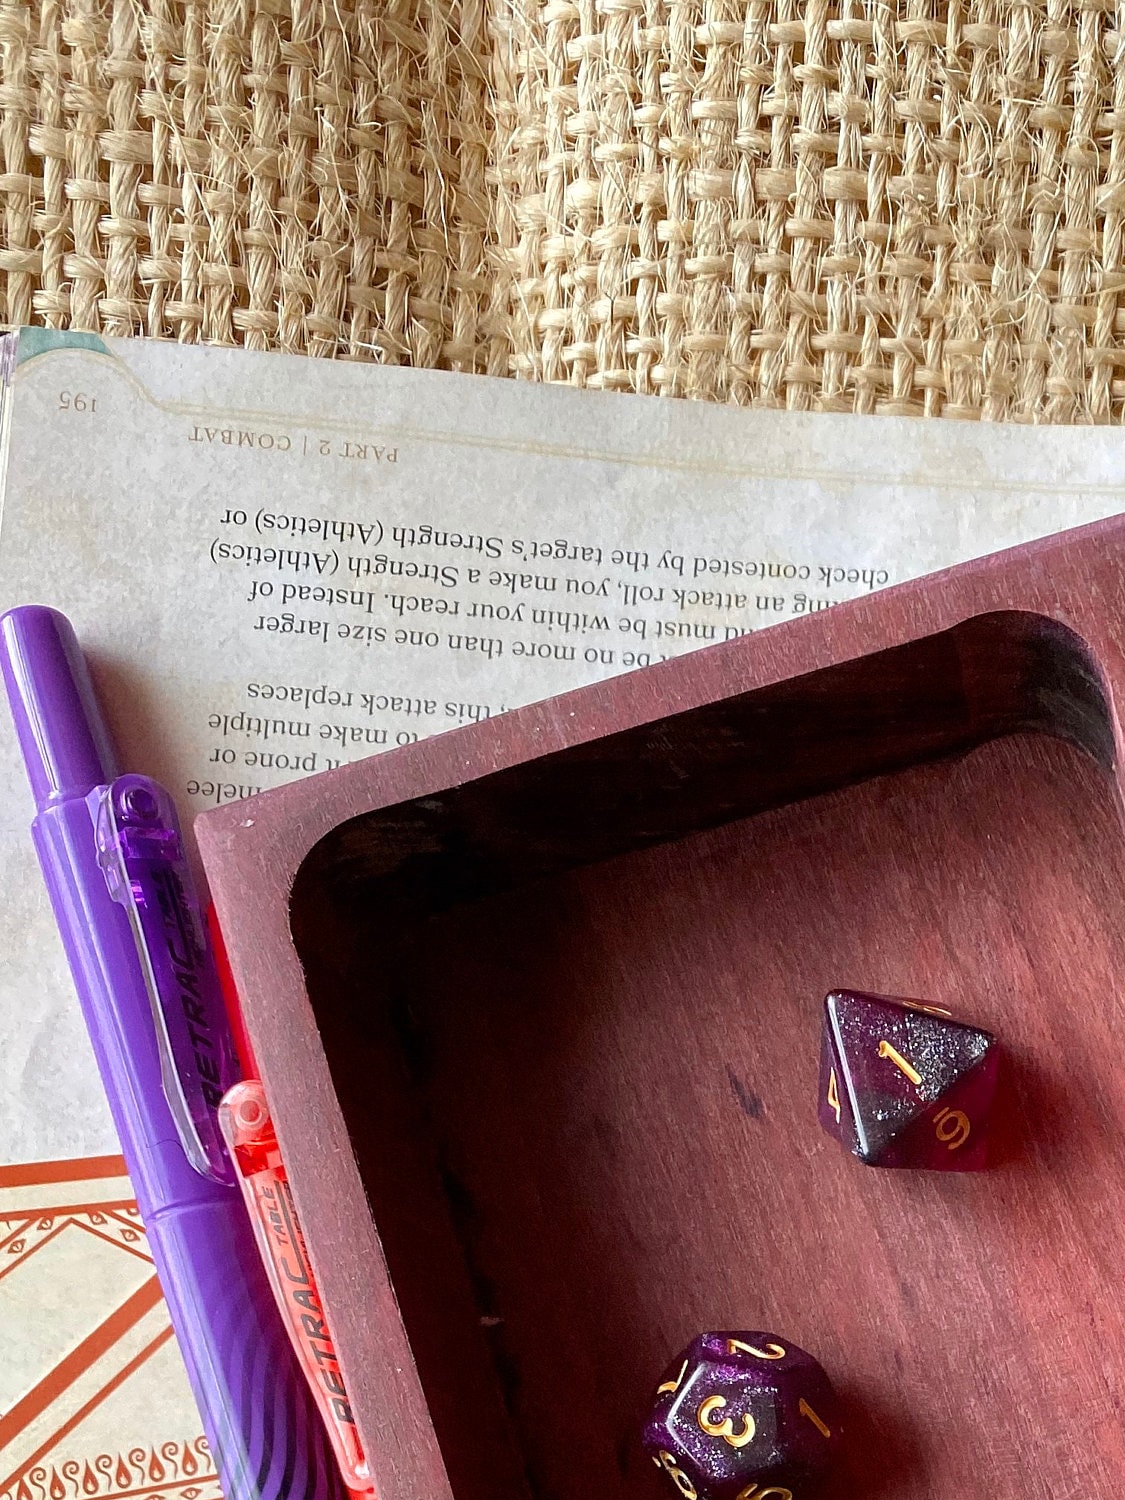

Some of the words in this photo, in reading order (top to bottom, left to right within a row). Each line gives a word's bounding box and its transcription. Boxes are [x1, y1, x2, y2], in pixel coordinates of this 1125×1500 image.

[59, 392, 96, 412] 195
[189, 426, 291, 451] COMBAT
[320, 440, 330, 455] 2
[339, 442, 397, 463] PART
[220, 509, 247, 528] or
[255, 506, 384, 548] (Athletics)
[392, 522, 503, 558] Strength
[512, 539, 602, 566] target's
[611, 550, 649, 572] the
[656, 550, 684, 576] by
[693, 558, 810, 580] contested
[818, 565, 889, 590] check
[247, 581, 273, 603] of
[282, 582, 375, 614] Instead
[383, 590, 460, 616] reach.
[467, 602, 526, 622] your
[532, 608, 610, 634] within
[619, 618, 646, 640] be
[655, 621, 716, 639] must
[878, 1040, 922, 1084] 1
[261, 1186, 288, 1246] TABLE
[697, 1395, 755, 1447] 3
[799, 1398, 831, 1439] 1
